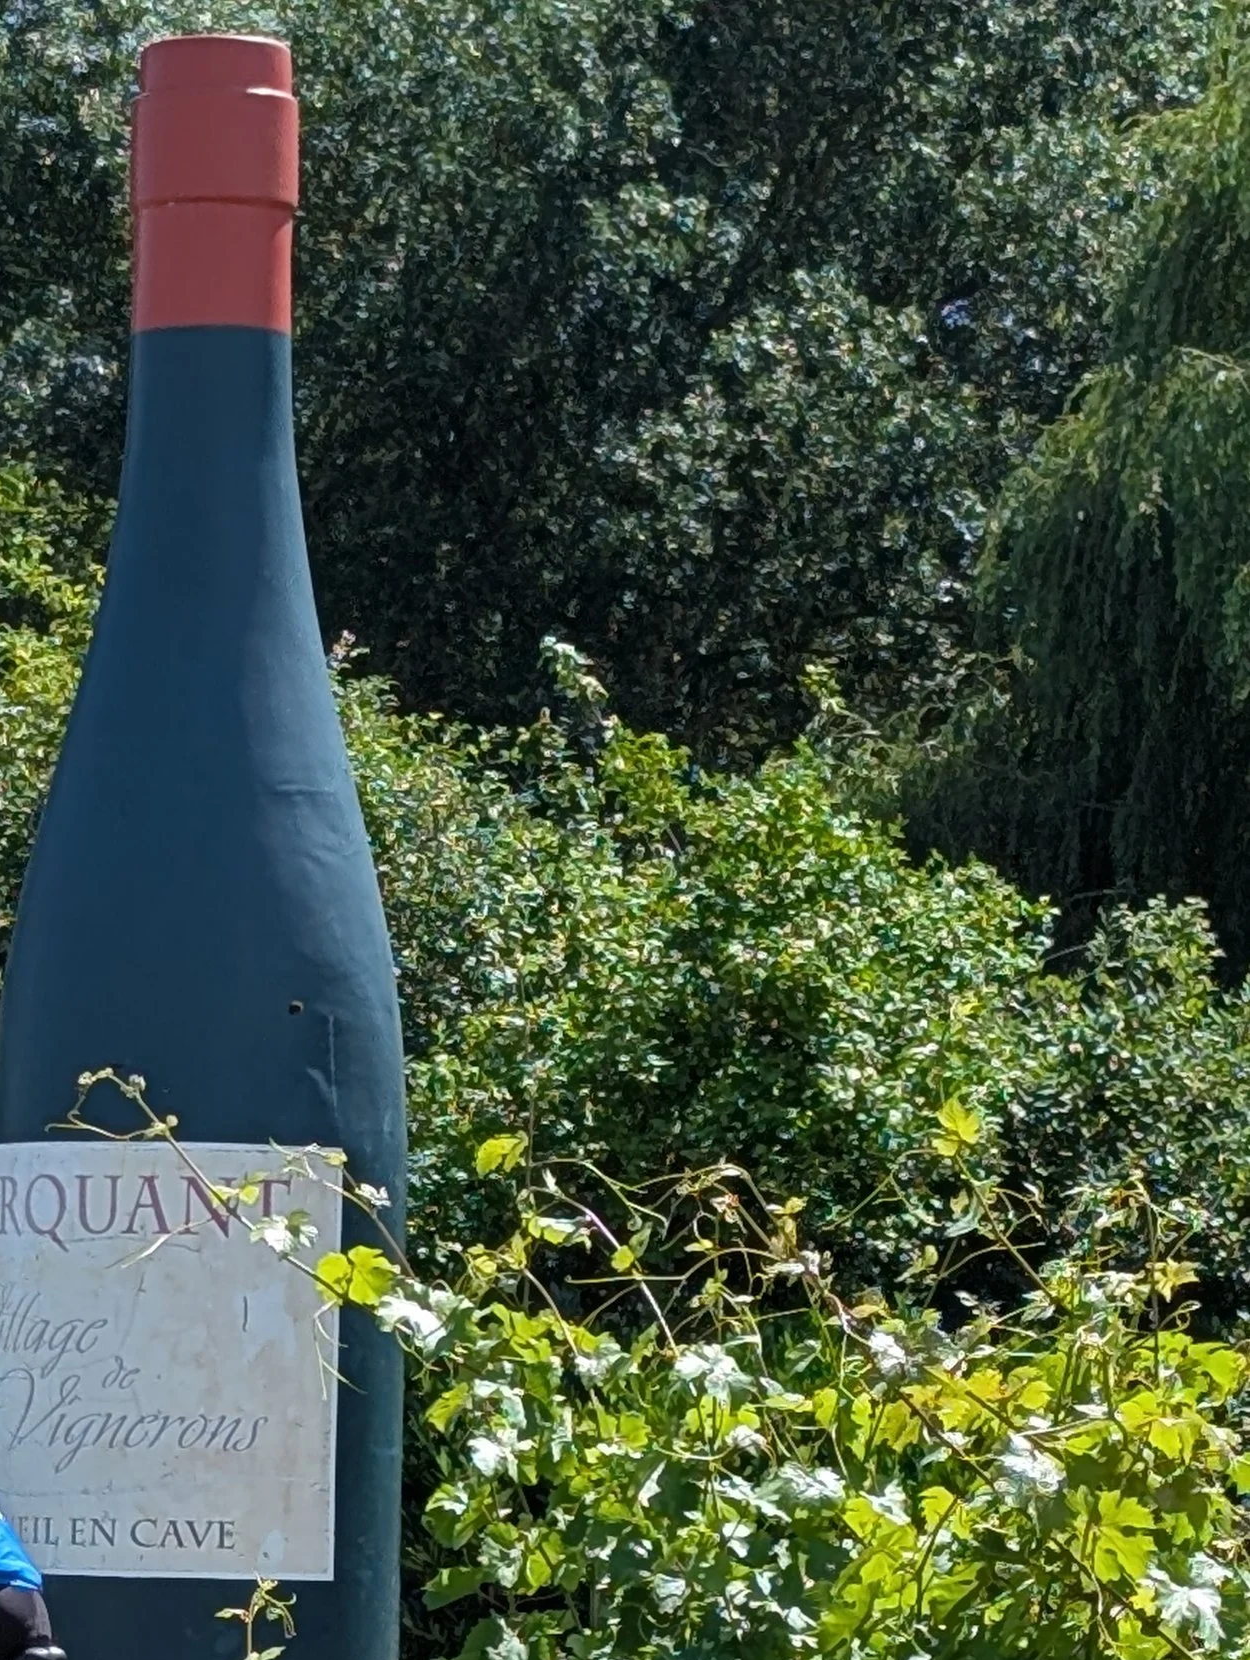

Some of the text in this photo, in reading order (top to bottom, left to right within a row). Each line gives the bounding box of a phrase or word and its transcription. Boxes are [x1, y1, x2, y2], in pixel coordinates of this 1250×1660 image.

[101, 1355, 141, 1389] de
[12, 1515, 237, 1550] EIL EN CAVE
